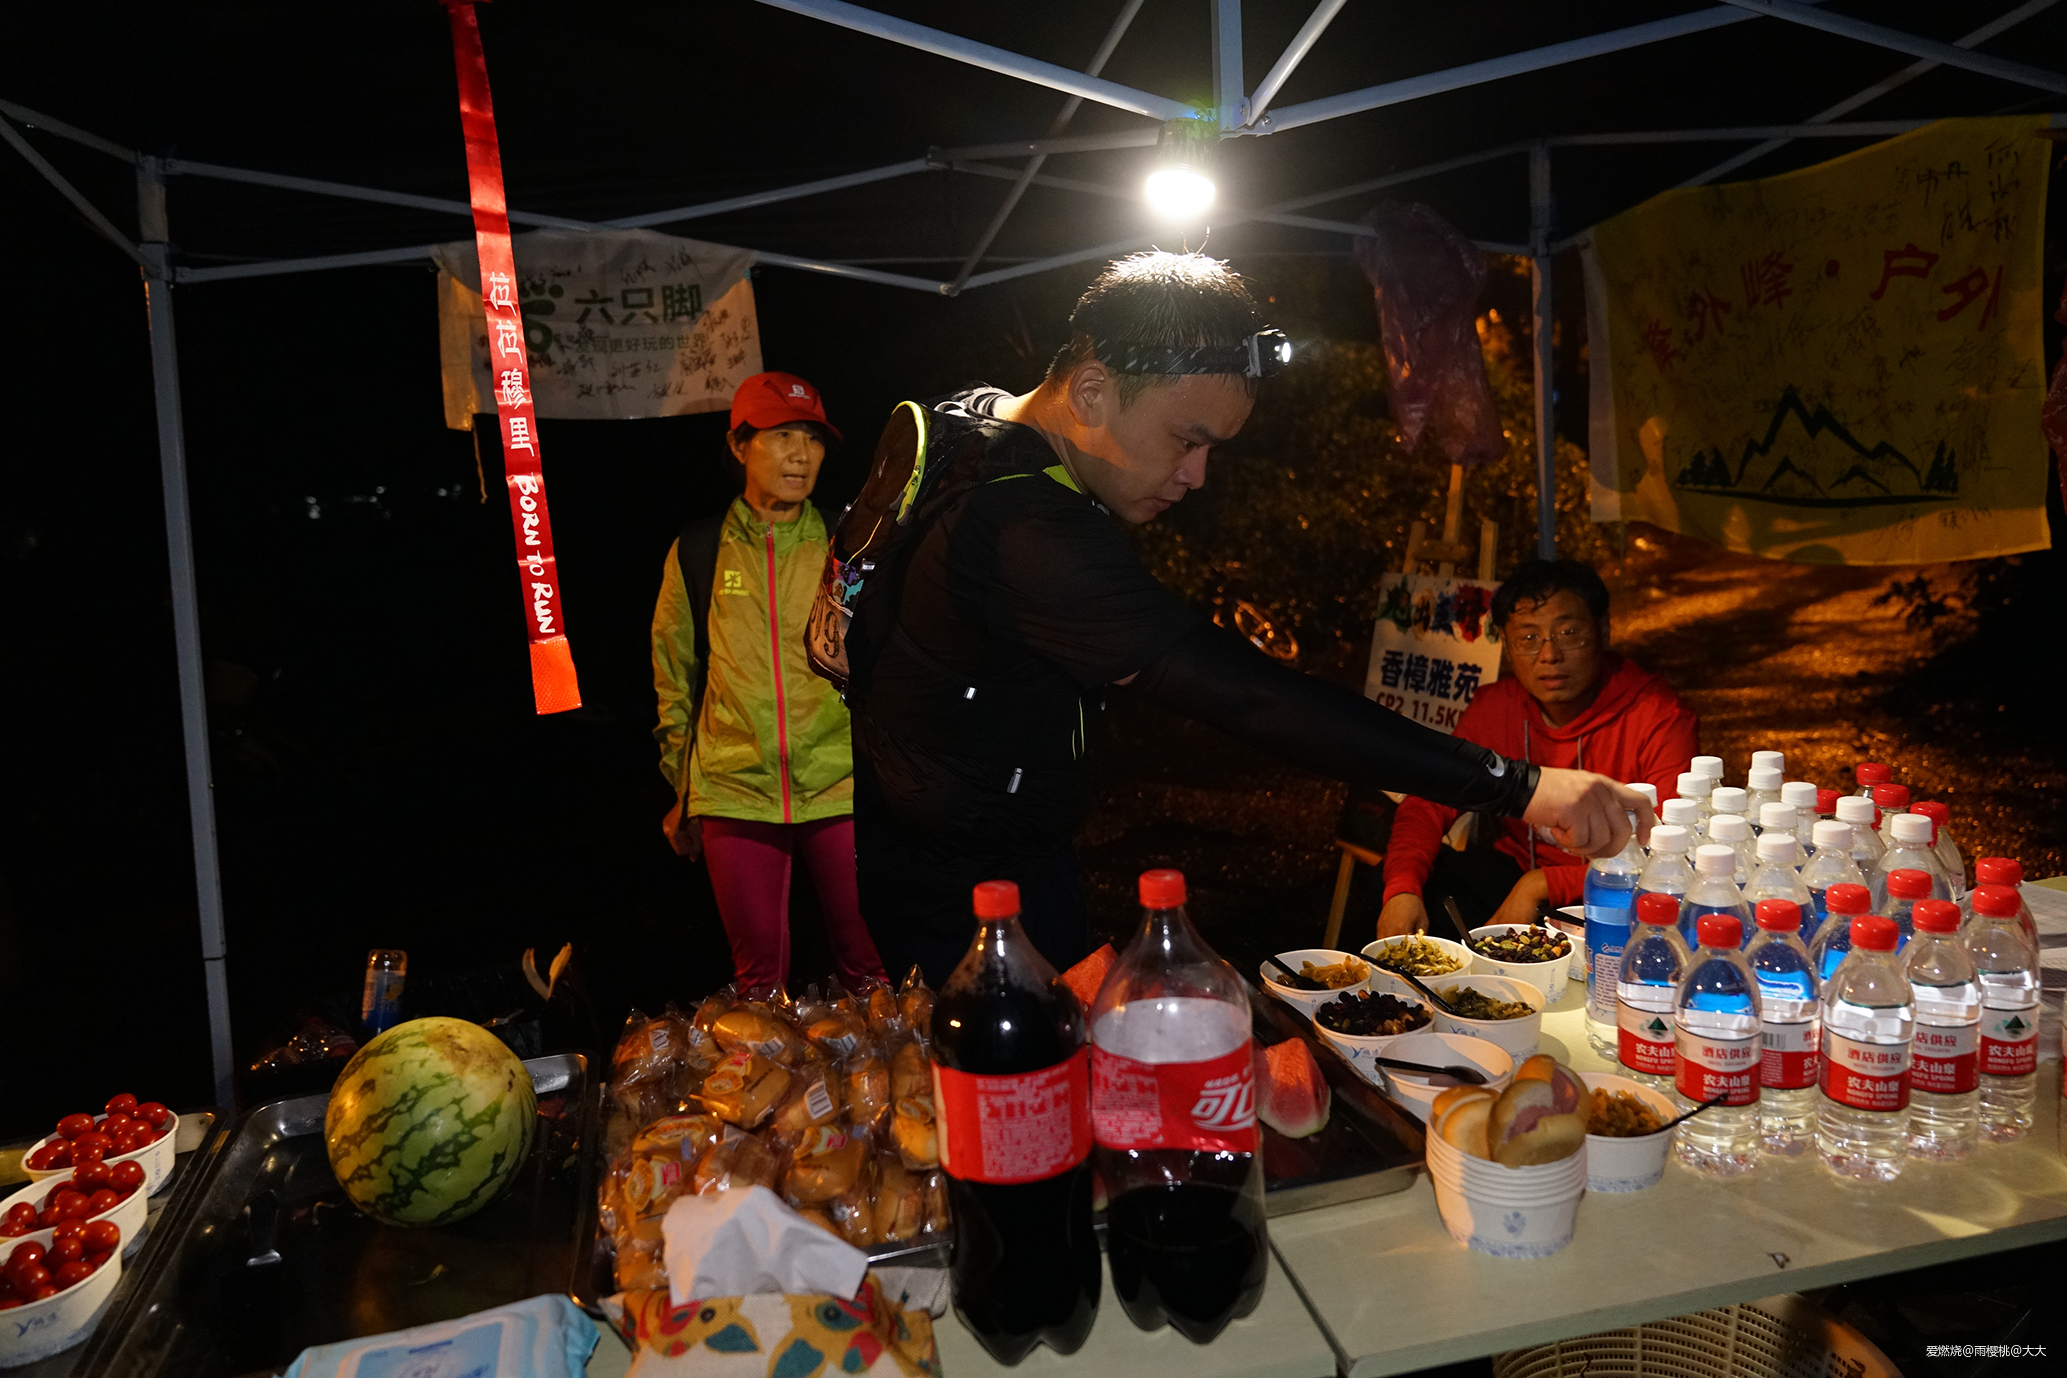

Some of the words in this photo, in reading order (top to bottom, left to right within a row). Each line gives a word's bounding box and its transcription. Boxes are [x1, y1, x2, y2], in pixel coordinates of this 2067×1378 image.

[574, 284, 702, 326] 六只脚
[514, 472, 541, 546] BORN
[526, 549, 545, 576] TO
[531, 582, 556, 634] RUN
[1381, 650, 1482, 703] 香樟雅苑
[1702, 1045, 1751, 1060] 酒店供应
[1847, 1047, 1902, 1064] 酒店供应
[1987, 1043, 2034, 1058] 农夫山泉
[1911, 1059, 1956, 1075] 夫山泉
[1703, 1074, 1750, 1088] 农夫山泉
[1846, 1076, 1900, 1092] 农夫山泉
